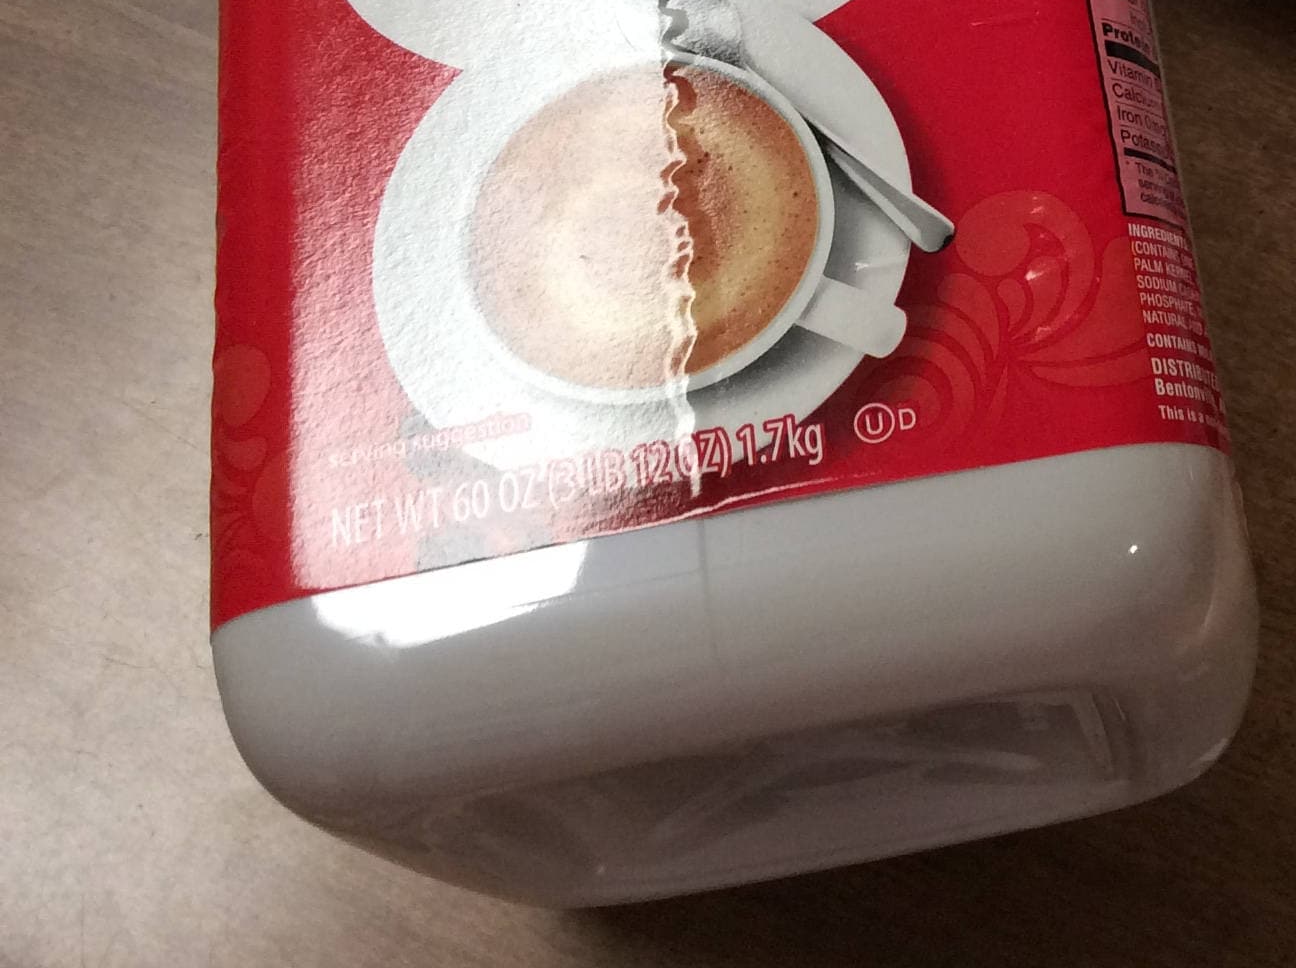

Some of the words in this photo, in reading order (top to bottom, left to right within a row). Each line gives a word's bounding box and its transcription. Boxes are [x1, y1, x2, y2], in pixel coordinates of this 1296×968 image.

[1117, 105, 1143, 124] Iron
[1134, 258, 1163, 273] PALM
[1136, 275, 1177, 292] SODIUM
[1143, 310, 1187, 328] NATURAL
[1158, 404, 1184, 421] This
[1187, 408, 1197, 422] is
[412, 413, 530, 453] suggestion
[331, 499, 384, 547] NET
[397, 487, 441, 529] WT
[452, 479, 491, 523] 60
[499, 466, 545, 512] OZ
[632, 440, 673, 484] 12
[737, 415, 823, 466] 1.7kg
